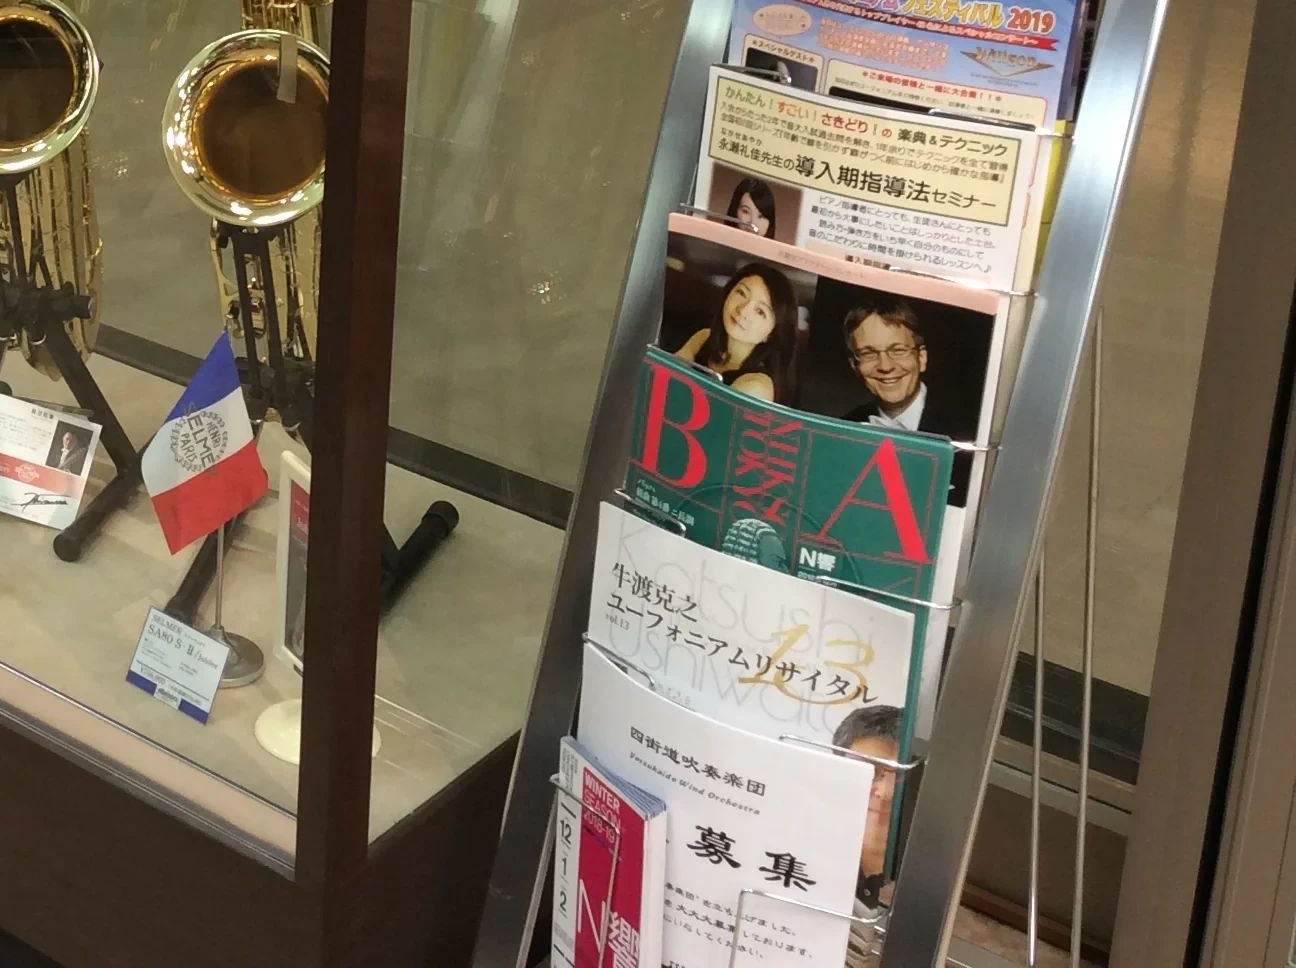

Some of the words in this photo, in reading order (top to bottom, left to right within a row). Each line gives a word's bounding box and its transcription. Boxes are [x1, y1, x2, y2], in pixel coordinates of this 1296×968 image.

[1006, 6, 1056, 35] 2019
[181, 432, 197, 463] PARIS
[207, 422, 222, 448] HENRI
[611, 561, 699, 624] 牛渡克之
[148, 623, 173, 646] SA80
[606, 591, 879, 705] ユーフォニアムリサイタル
[738, 622, 876, 707] 13
[629, 726, 766, 798] 四街道吹奏楽団
[584, 772, 620, 816] WINTER
[679, 777, 706, 797] Wind
[707, 790, 762, 816] Orchestra
[559, 818, 572, 846] 12
[583, 812, 616, 847] 2018-19
[686, 824, 817, 892] 募集
[559, 890, 568, 913] 2
